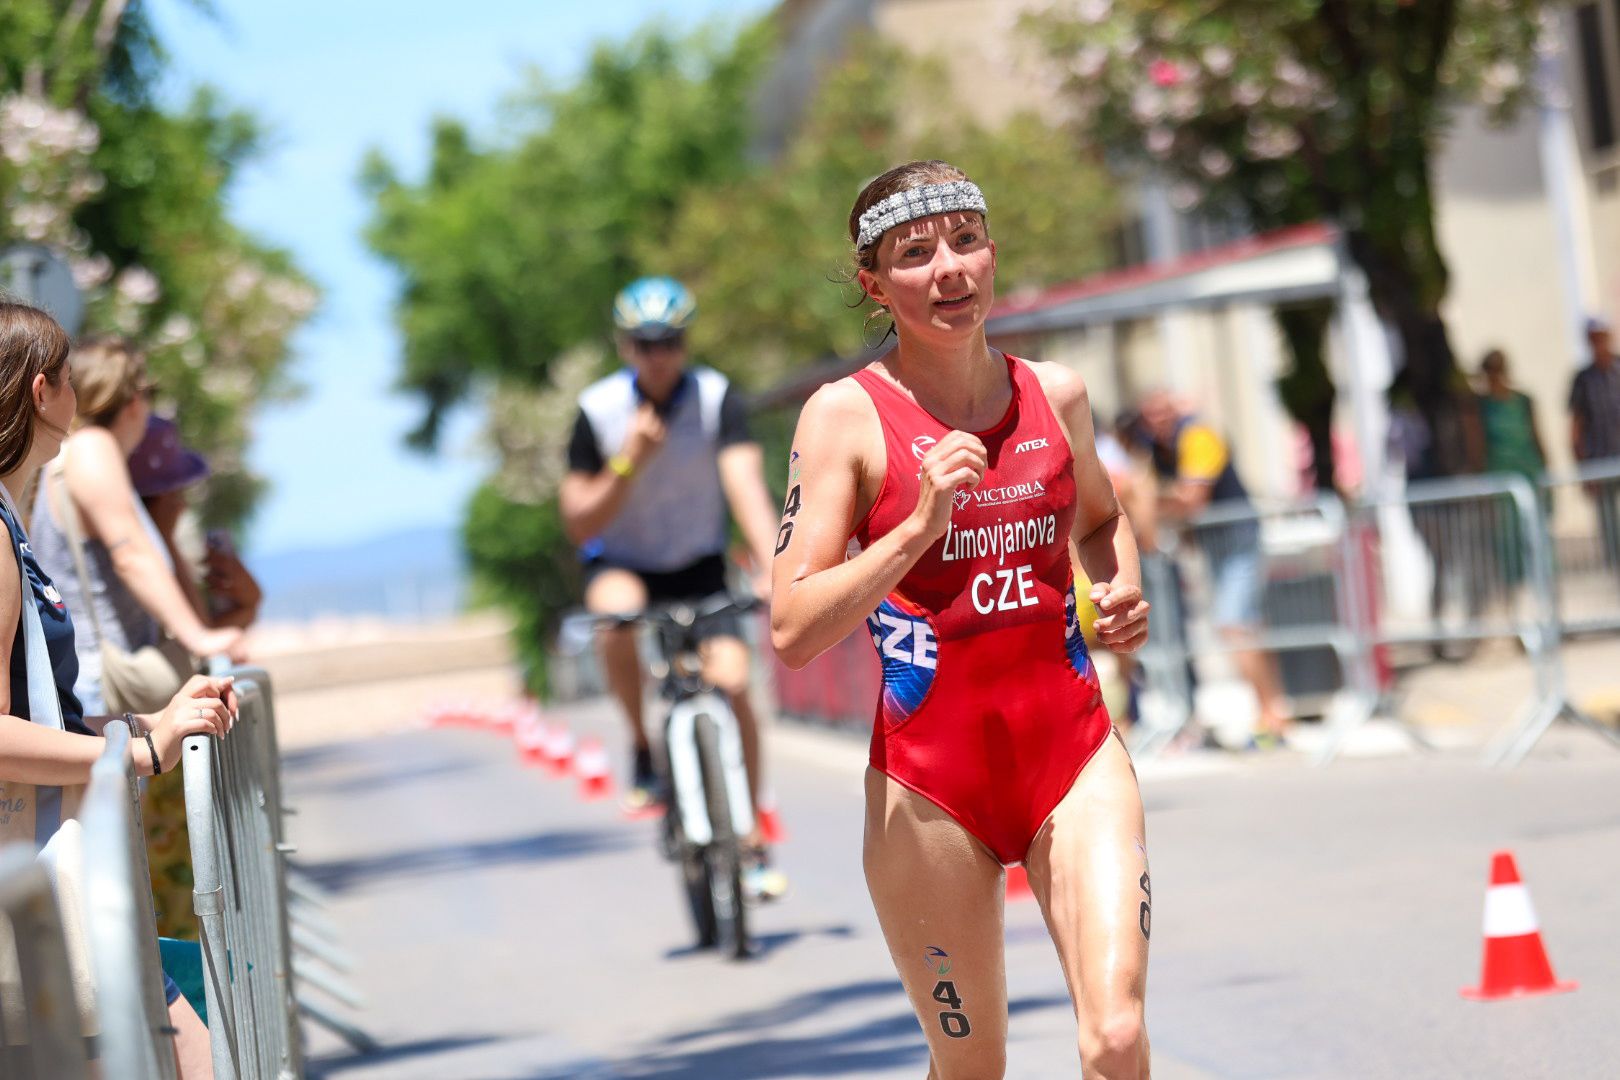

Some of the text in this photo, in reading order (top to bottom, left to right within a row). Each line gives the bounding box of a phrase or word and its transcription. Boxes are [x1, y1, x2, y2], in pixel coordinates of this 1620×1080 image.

[1015, 437, 1050, 454] ATEX
[973, 480, 1045, 502] VICTORIA
[774, 484, 801, 556] 40
[942, 514, 1056, 566] Zimovjanova
[971, 564, 1039, 615] CZE
[932, 981, 971, 1038] 40
